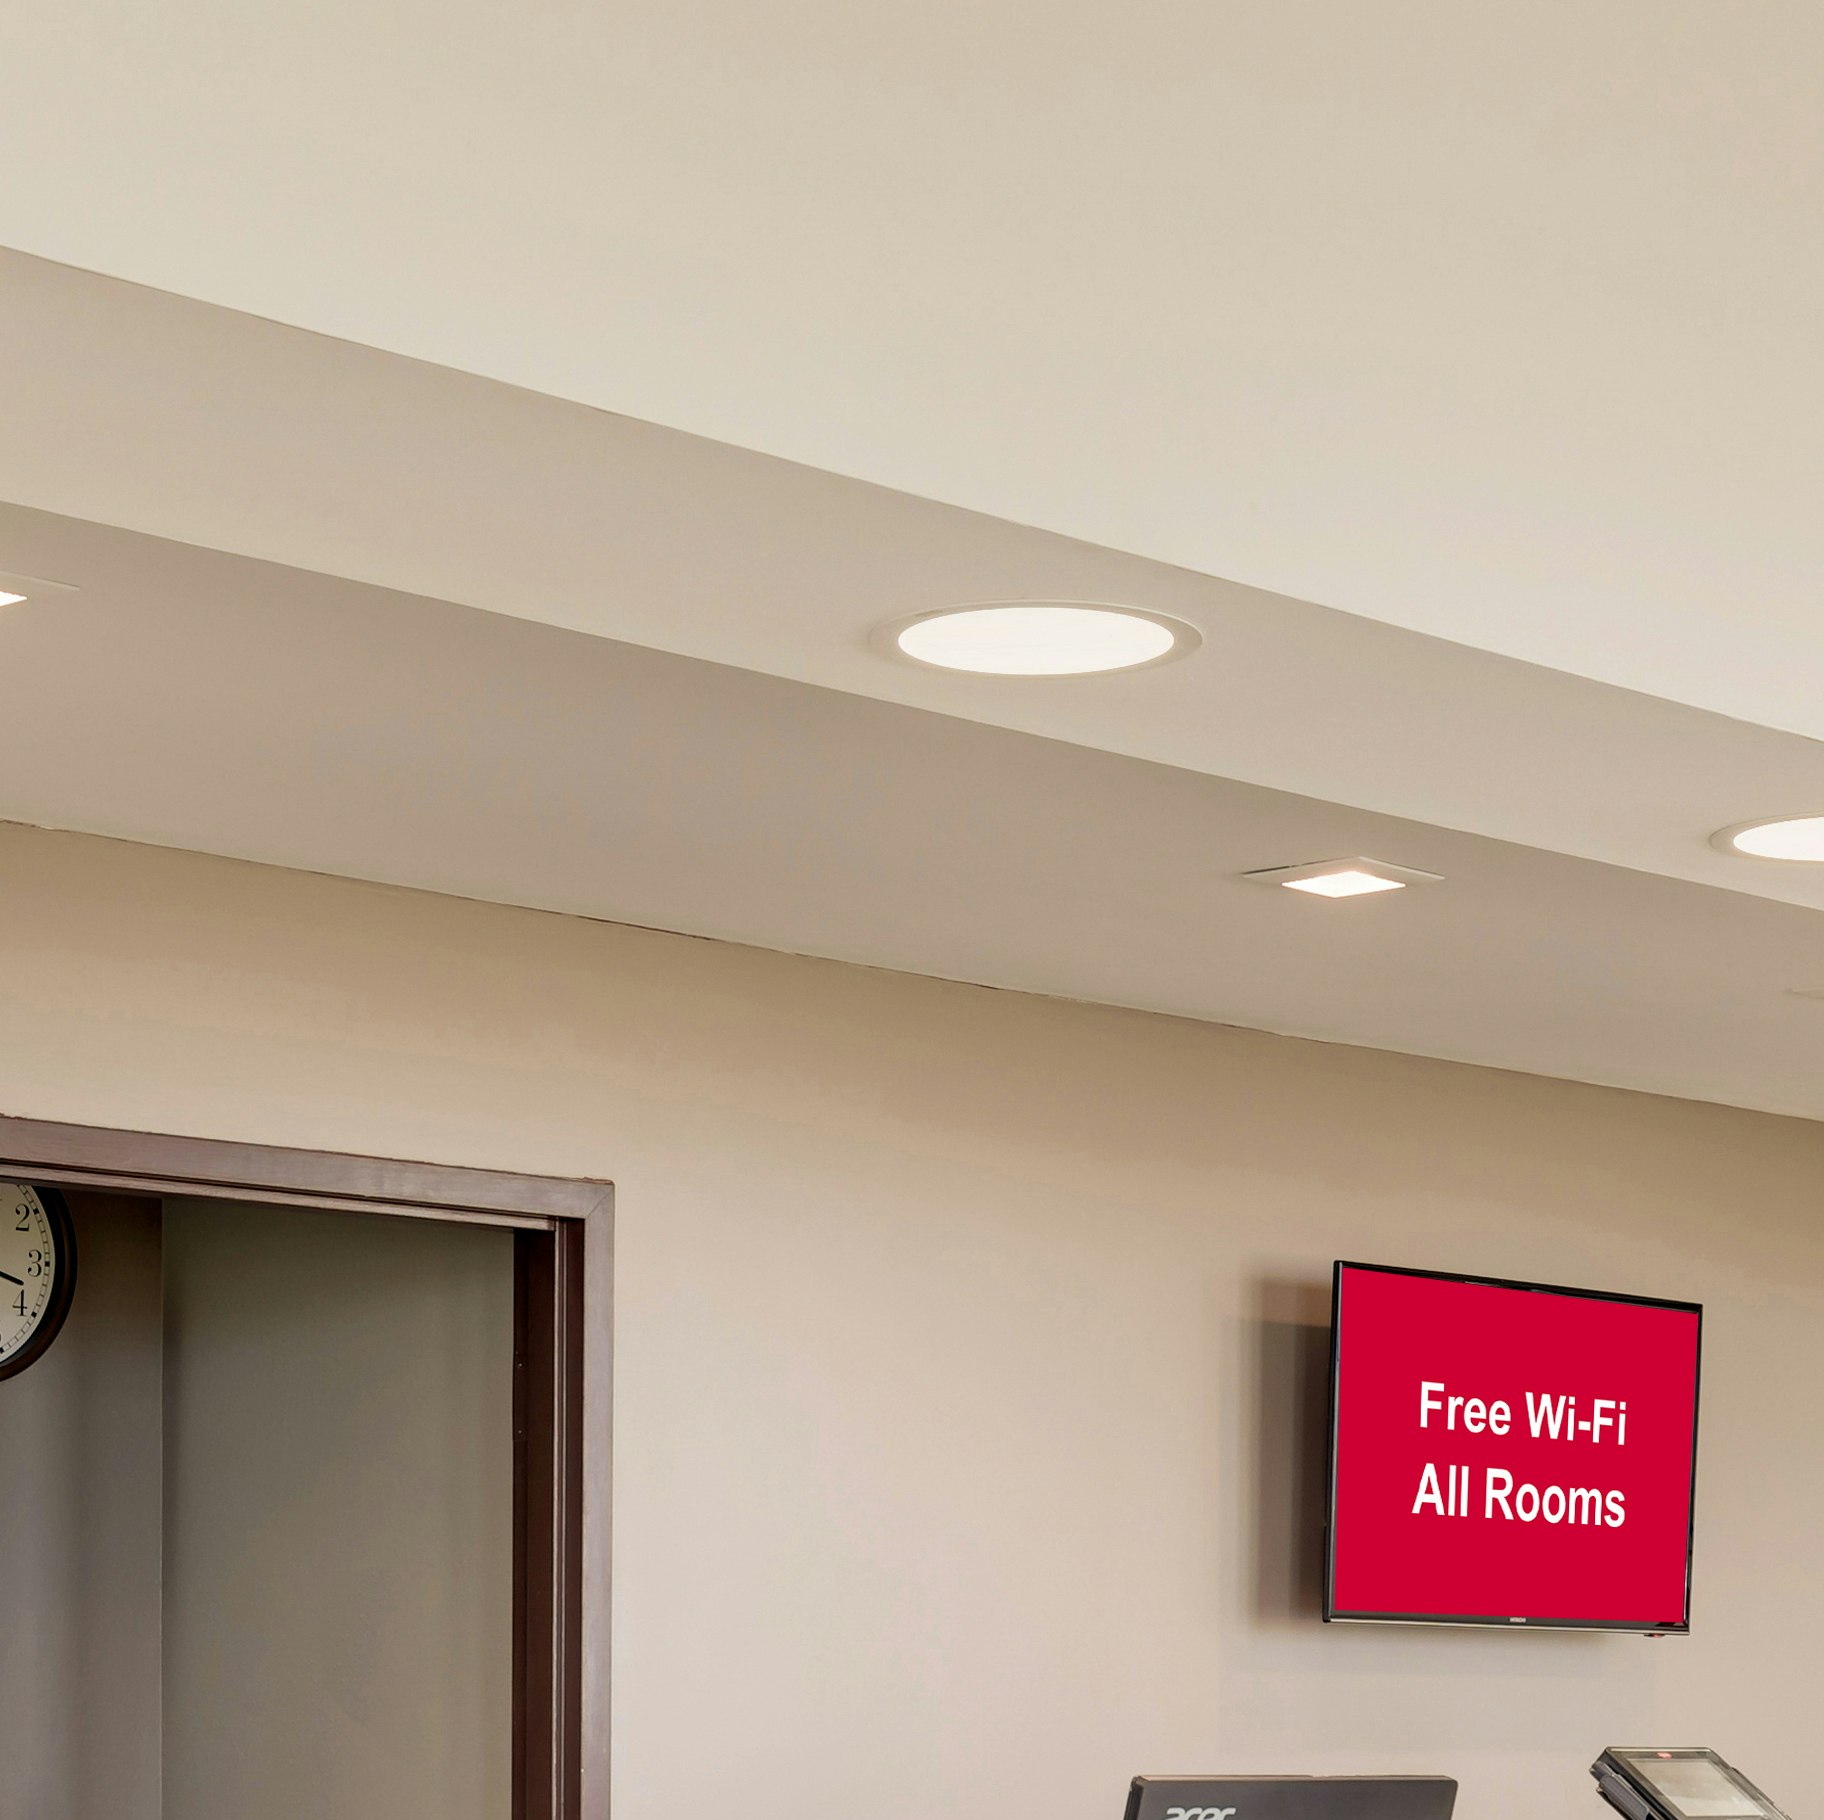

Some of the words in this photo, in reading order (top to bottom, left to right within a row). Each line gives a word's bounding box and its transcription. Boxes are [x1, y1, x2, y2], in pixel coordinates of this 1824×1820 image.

[15, 1203, 30, 1232] 2
[27, 1249, 42, 1278] 3
[12, 1289, 28, 1317] 4
[1419, 1380, 1512, 1436] Free
[1525, 1391, 1627, 1446] Wi-Fi
[1411, 1462, 1470, 1517] All
[1484, 1467, 1626, 1528] Rooms
